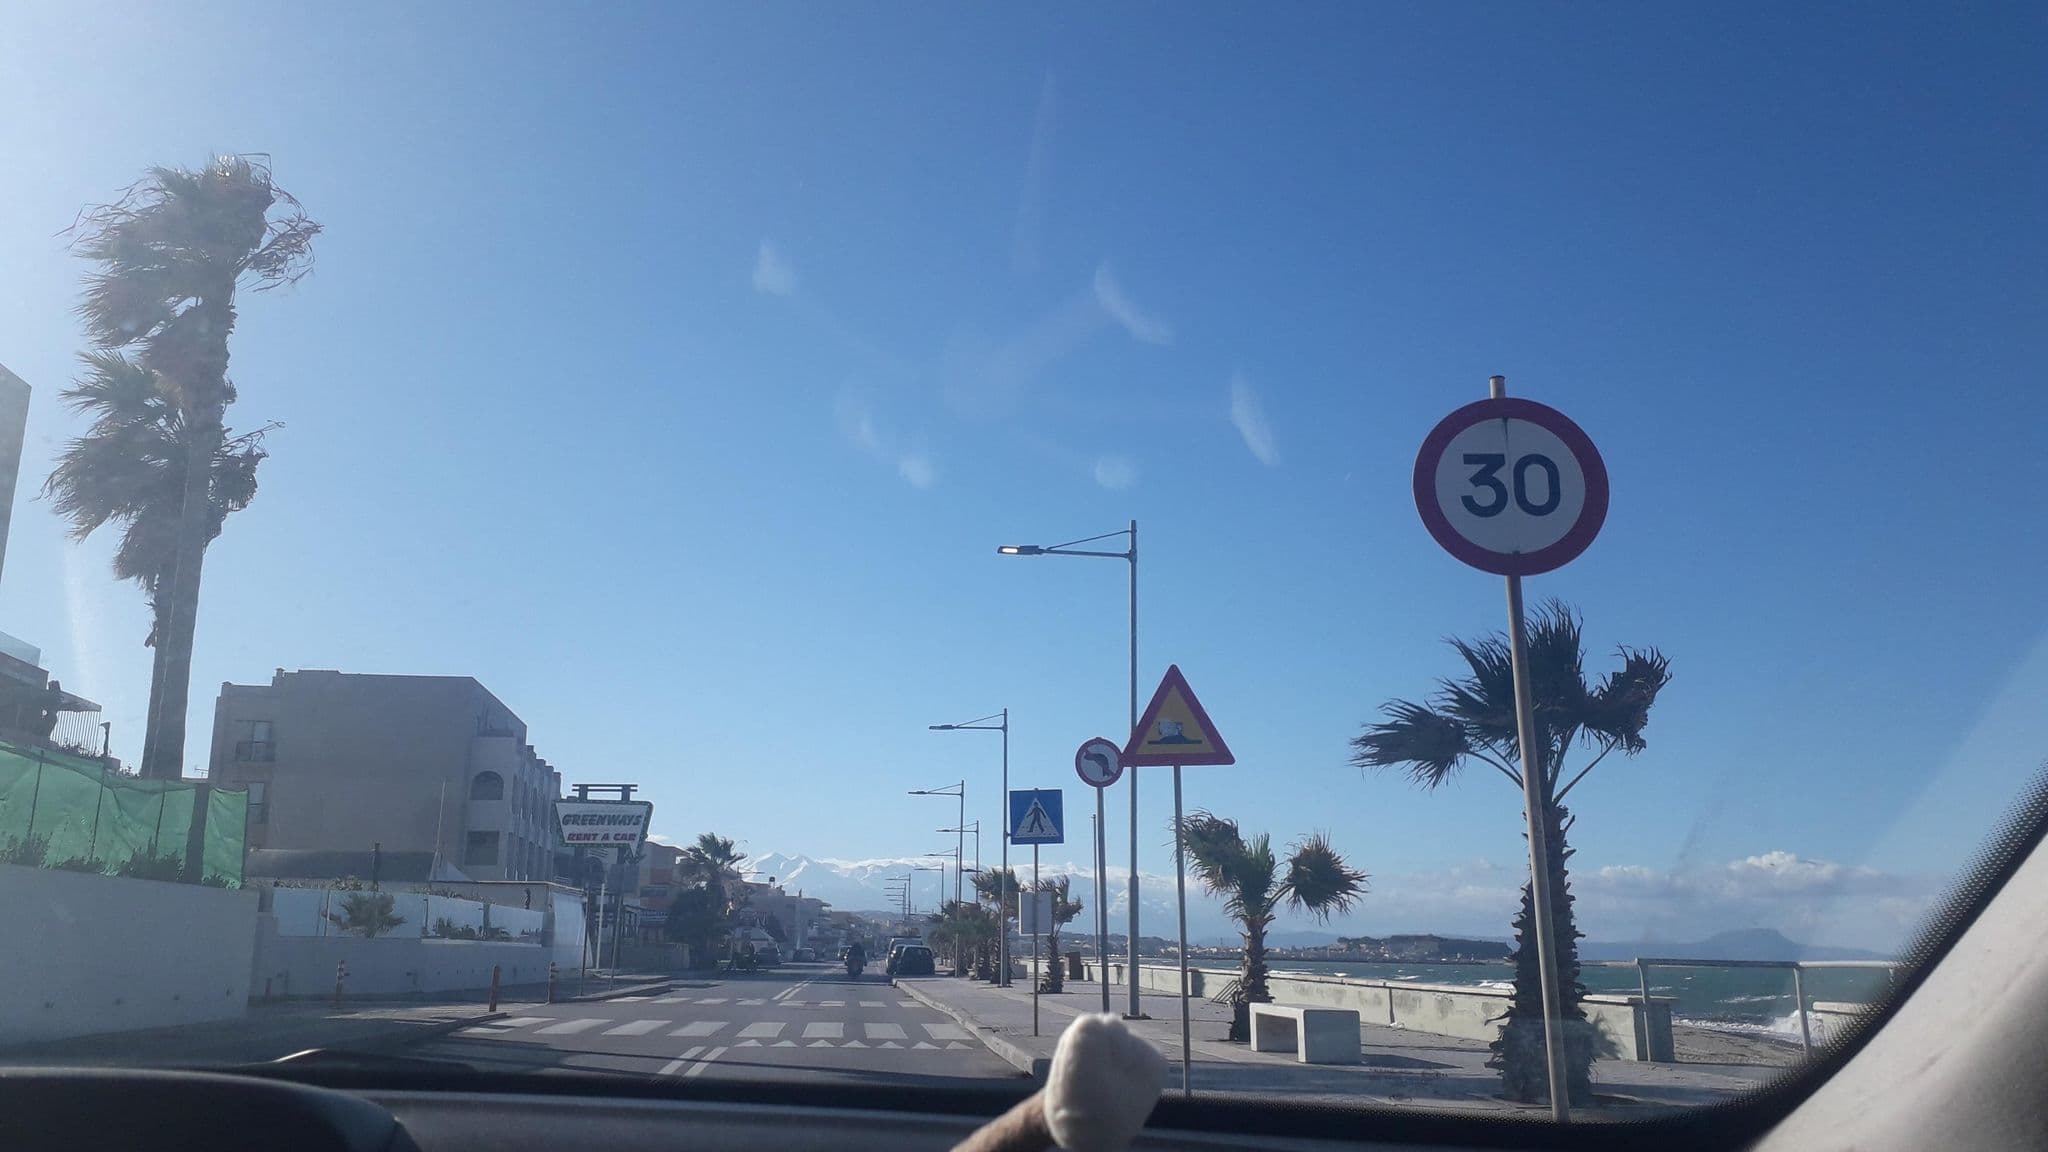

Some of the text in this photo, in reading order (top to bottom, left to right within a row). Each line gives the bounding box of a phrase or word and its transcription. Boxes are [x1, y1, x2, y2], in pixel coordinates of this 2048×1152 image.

[1461, 453, 1561, 518] 30
[562, 814, 642, 826] GREENWAYS
[567, 833, 637, 841] RENT A CAR
